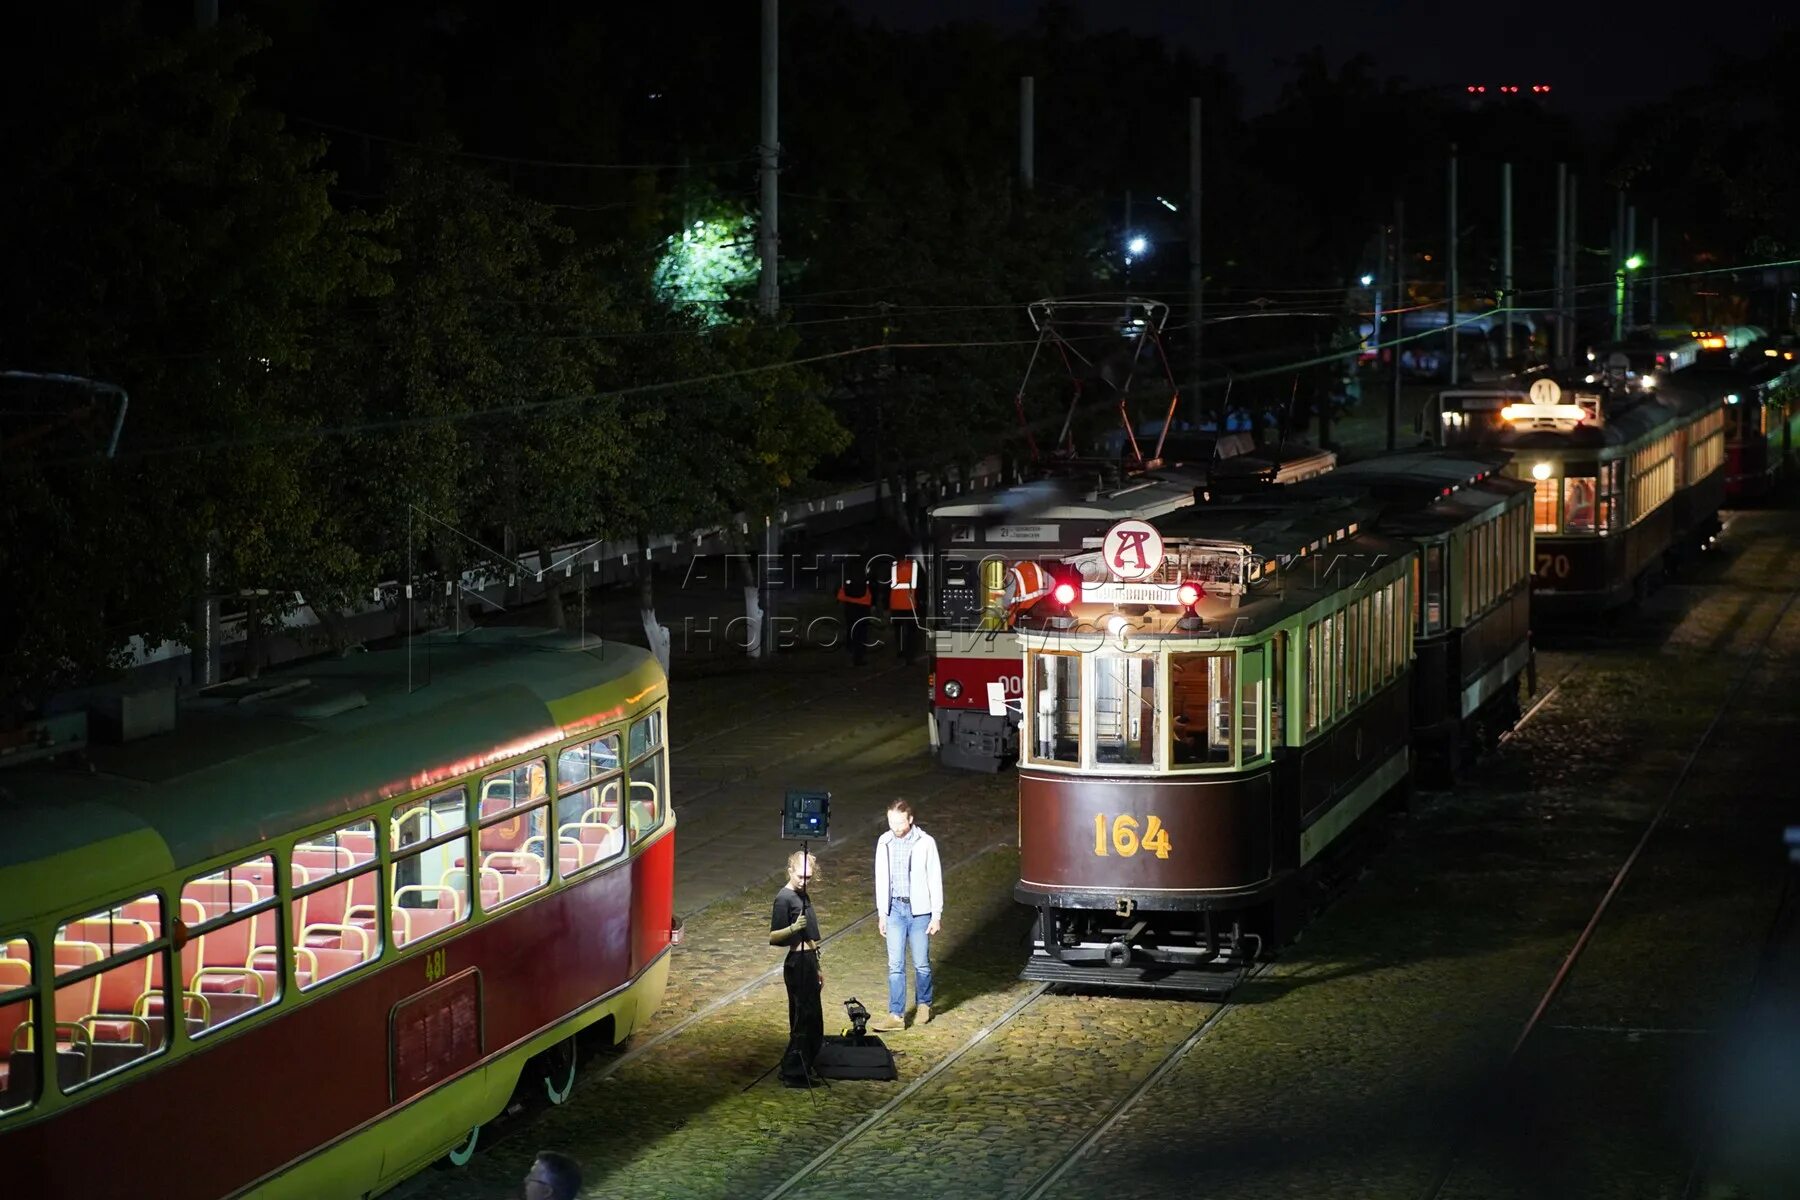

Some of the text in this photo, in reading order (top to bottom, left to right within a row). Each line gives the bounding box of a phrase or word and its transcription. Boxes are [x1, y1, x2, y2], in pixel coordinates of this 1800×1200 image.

[954, 526, 970, 540] 21
[998, 674, 1024, 694] 00
[1094, 812, 1172, 860] 164
[424, 947, 447, 983] 481
